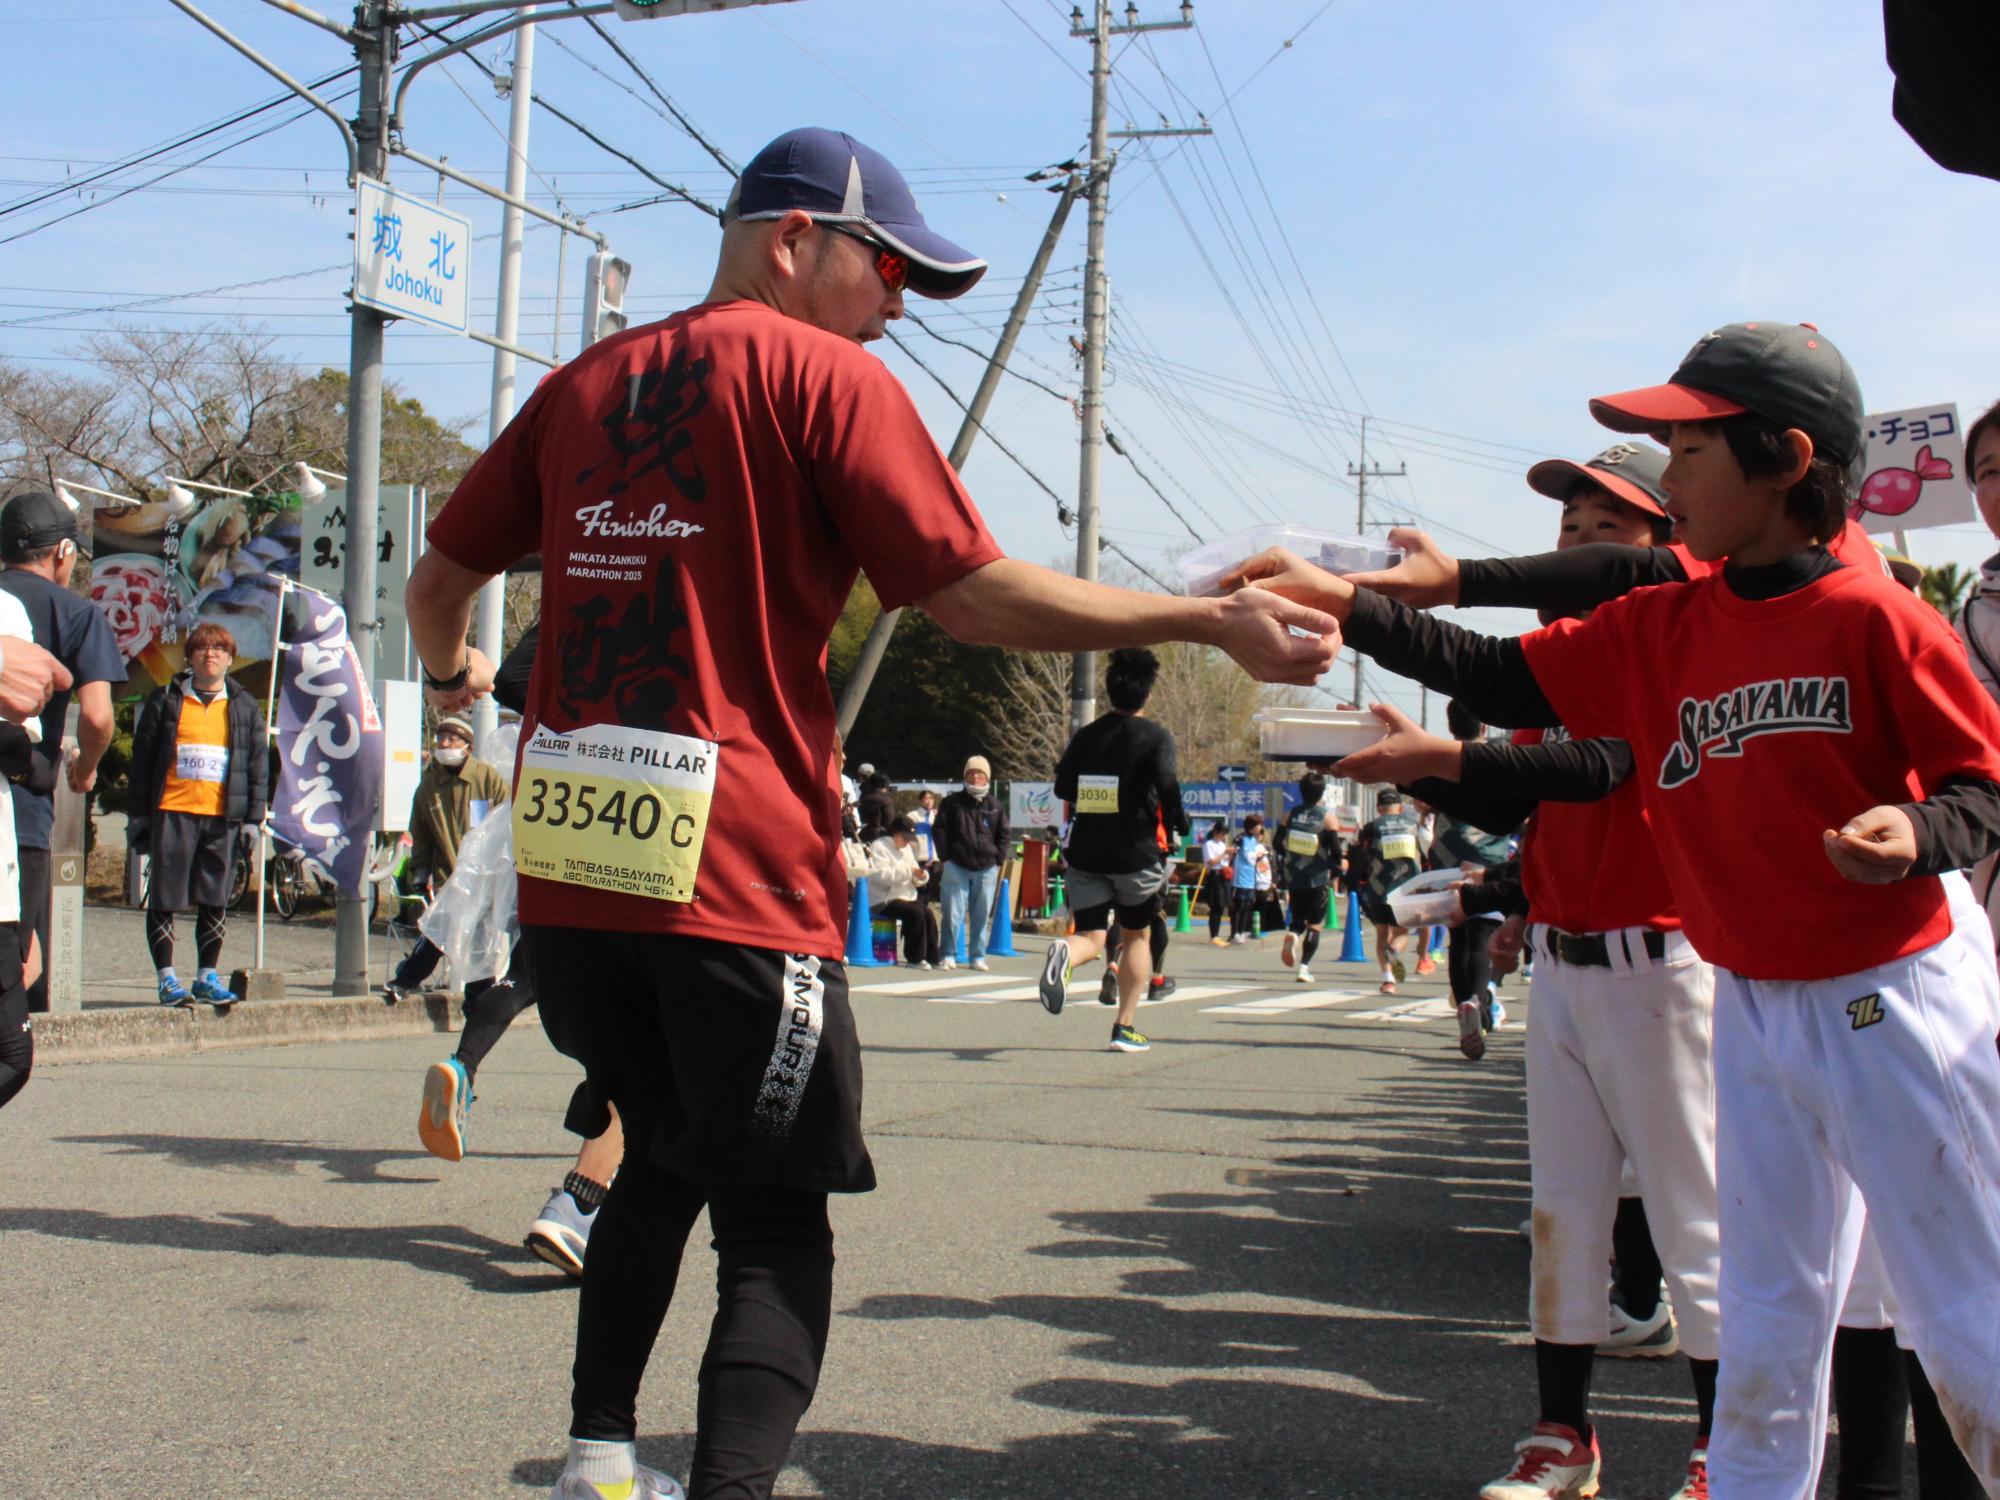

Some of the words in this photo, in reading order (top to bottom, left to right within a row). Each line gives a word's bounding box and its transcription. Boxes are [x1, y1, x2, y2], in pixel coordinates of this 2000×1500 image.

[372, 208, 456, 280] 城北
[385, 265, 443, 305] Johoku
[575, 500, 704, 538] Finisher
[566, 567, 622, 581] MARATHON
[624, 570, 642, 581] 2025
[569, 551, 606, 565] MIKATA
[609, 553, 647, 566] ZANKOKU
[532, 737, 571, 752] PILLAR
[1658, 677, 1852, 788] SASAYAMA
[577, 741, 625, 763] 株式会社
[630, 745, 707, 775] PILLAR
[1080, 788, 1108, 801] 3030
[522, 777, 661, 840] 33540
[671, 813, 695, 848] C
[563, 871, 583, 883] ABC
[584, 875, 641, 892] MARATHON
[564, 858, 674, 887] TAMBASASAYAMA
